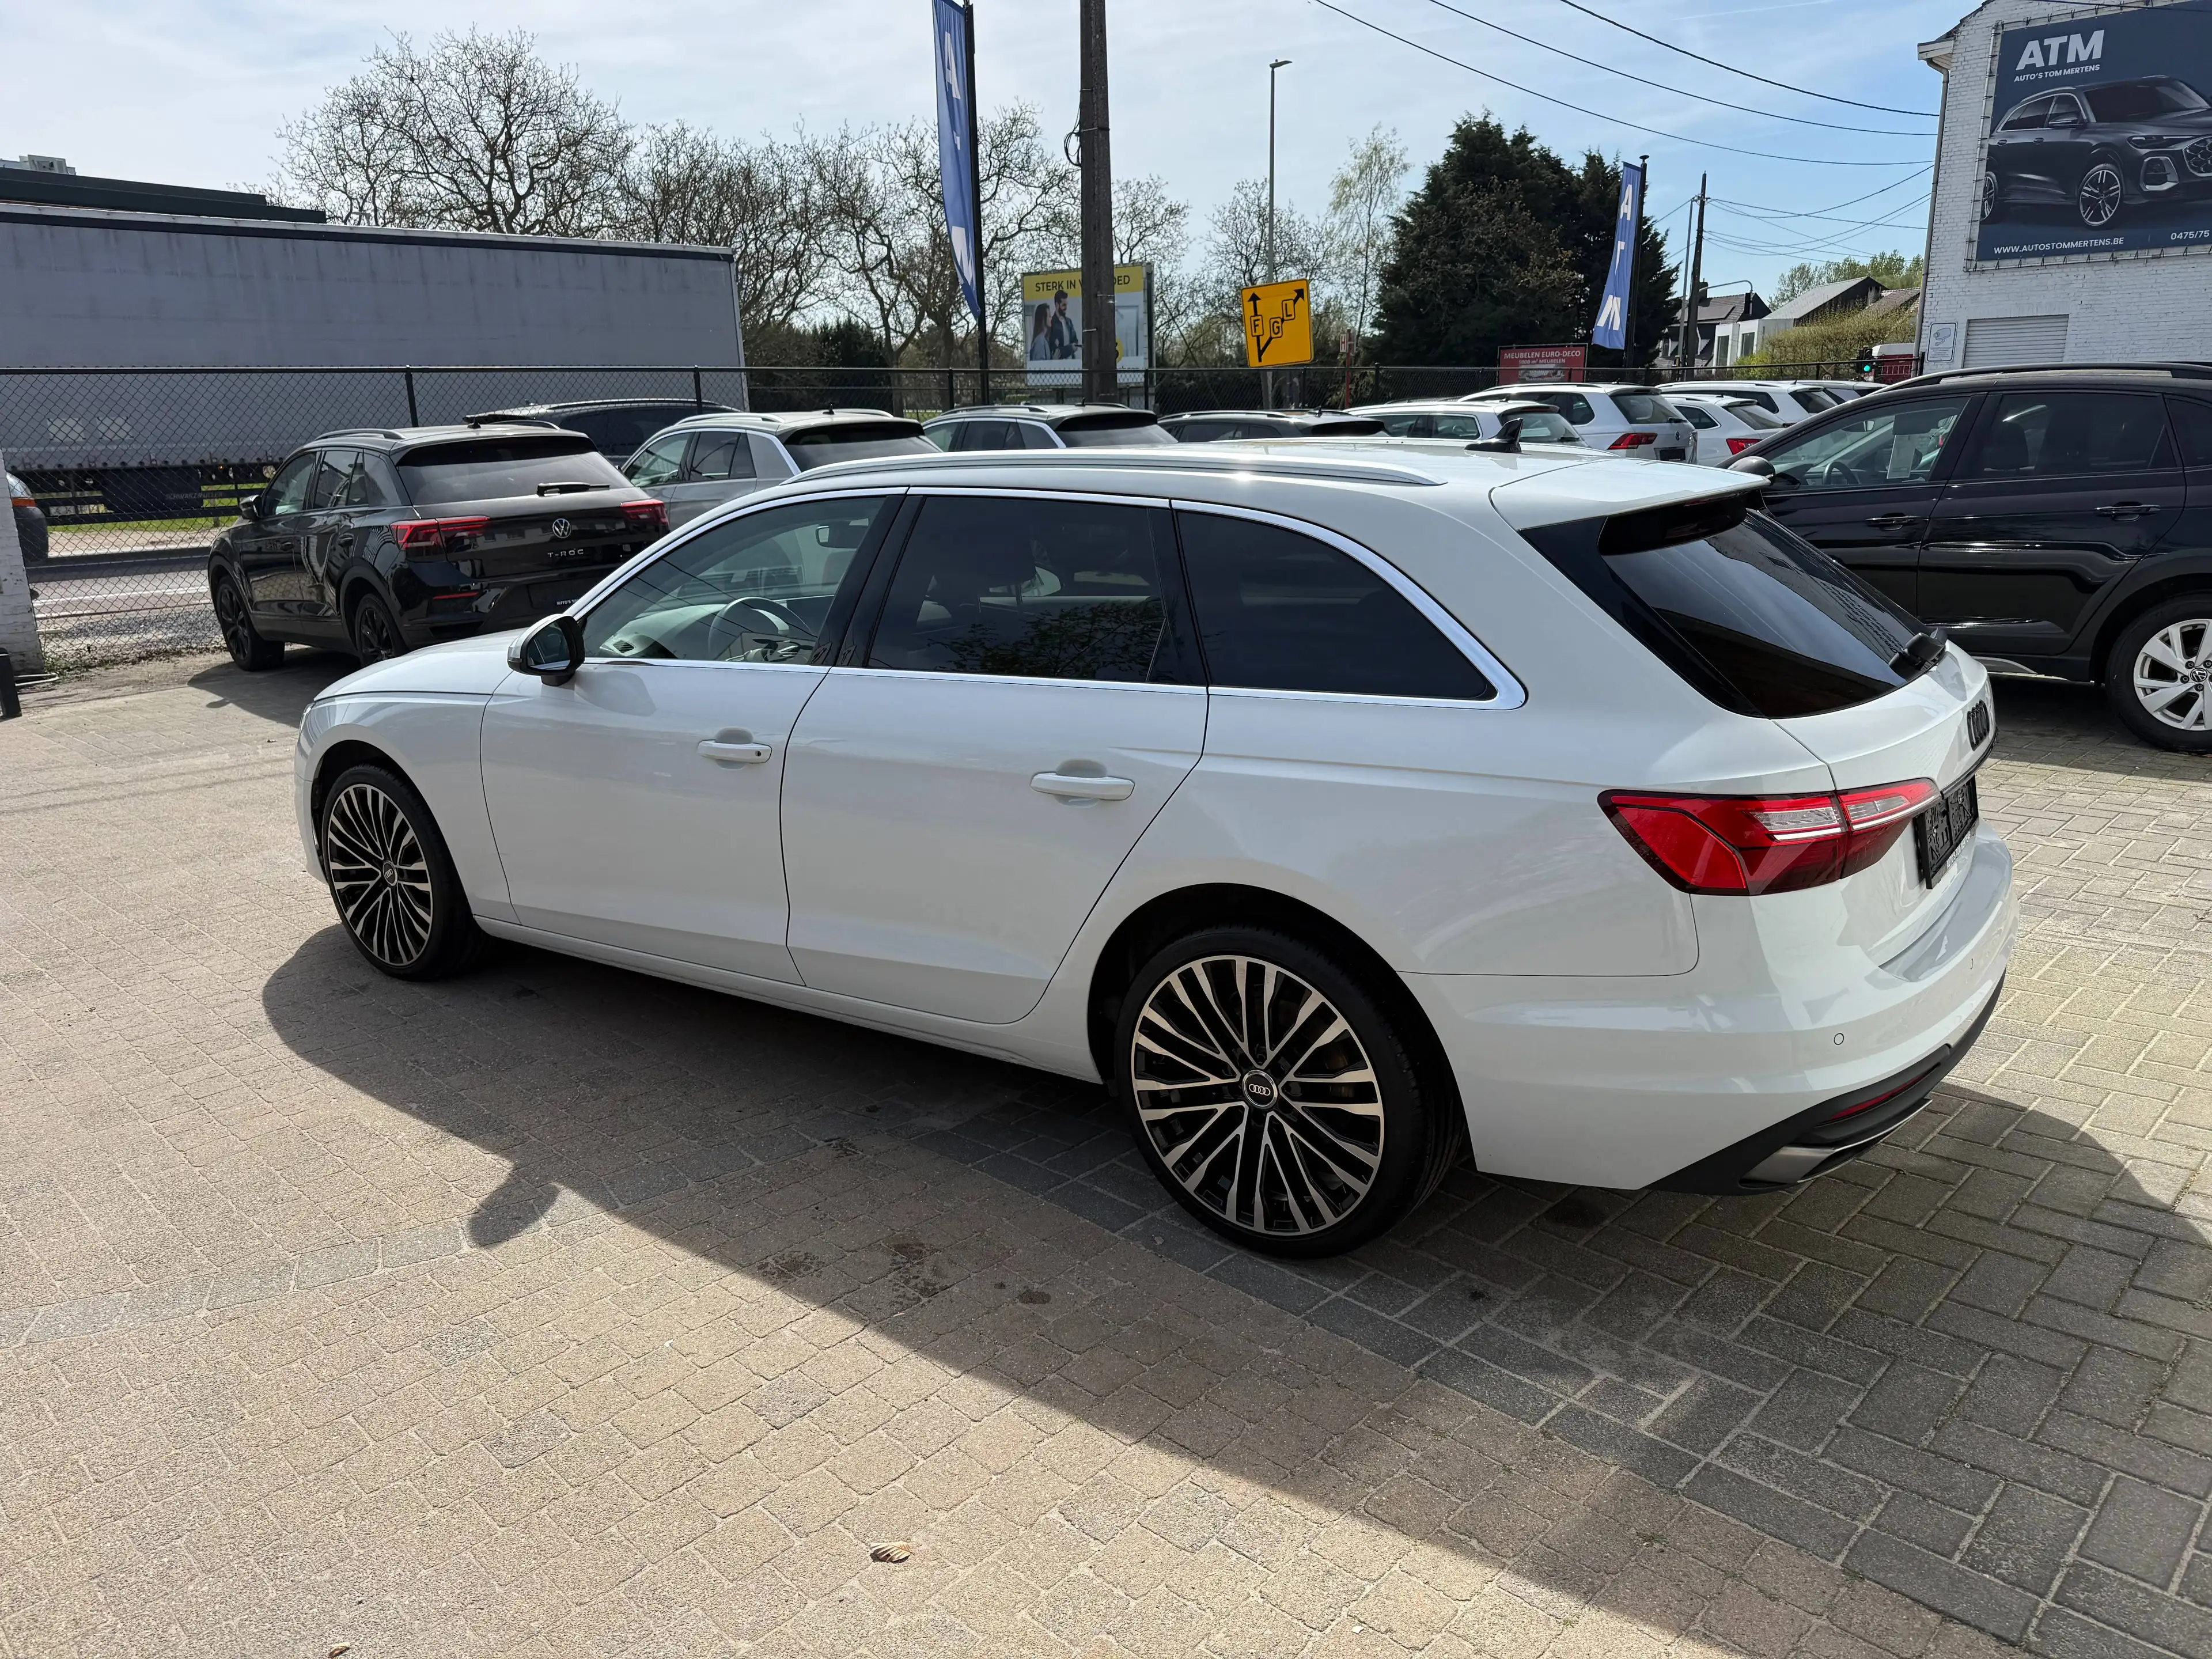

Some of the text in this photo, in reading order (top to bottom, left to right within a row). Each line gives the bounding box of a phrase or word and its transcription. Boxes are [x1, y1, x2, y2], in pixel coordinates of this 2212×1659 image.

[2016, 30, 2105, 70] ATM
[2014, 64, 2100, 82] AUTO'S TOM MERTENS
[2171, 230, 2210, 240] 0475/75
[1994, 237, 2124, 254] WWW.AUTOSTOMMERTENS.BE
[1035, 281, 1064, 291] STERK
[1067, 280, 1076, 289] IN
[1285, 303, 1292, 317] L
[1253, 319, 1260, 333] F
[1272, 321, 1280, 335] G
[547, 549, 584, 558] T-ROC
